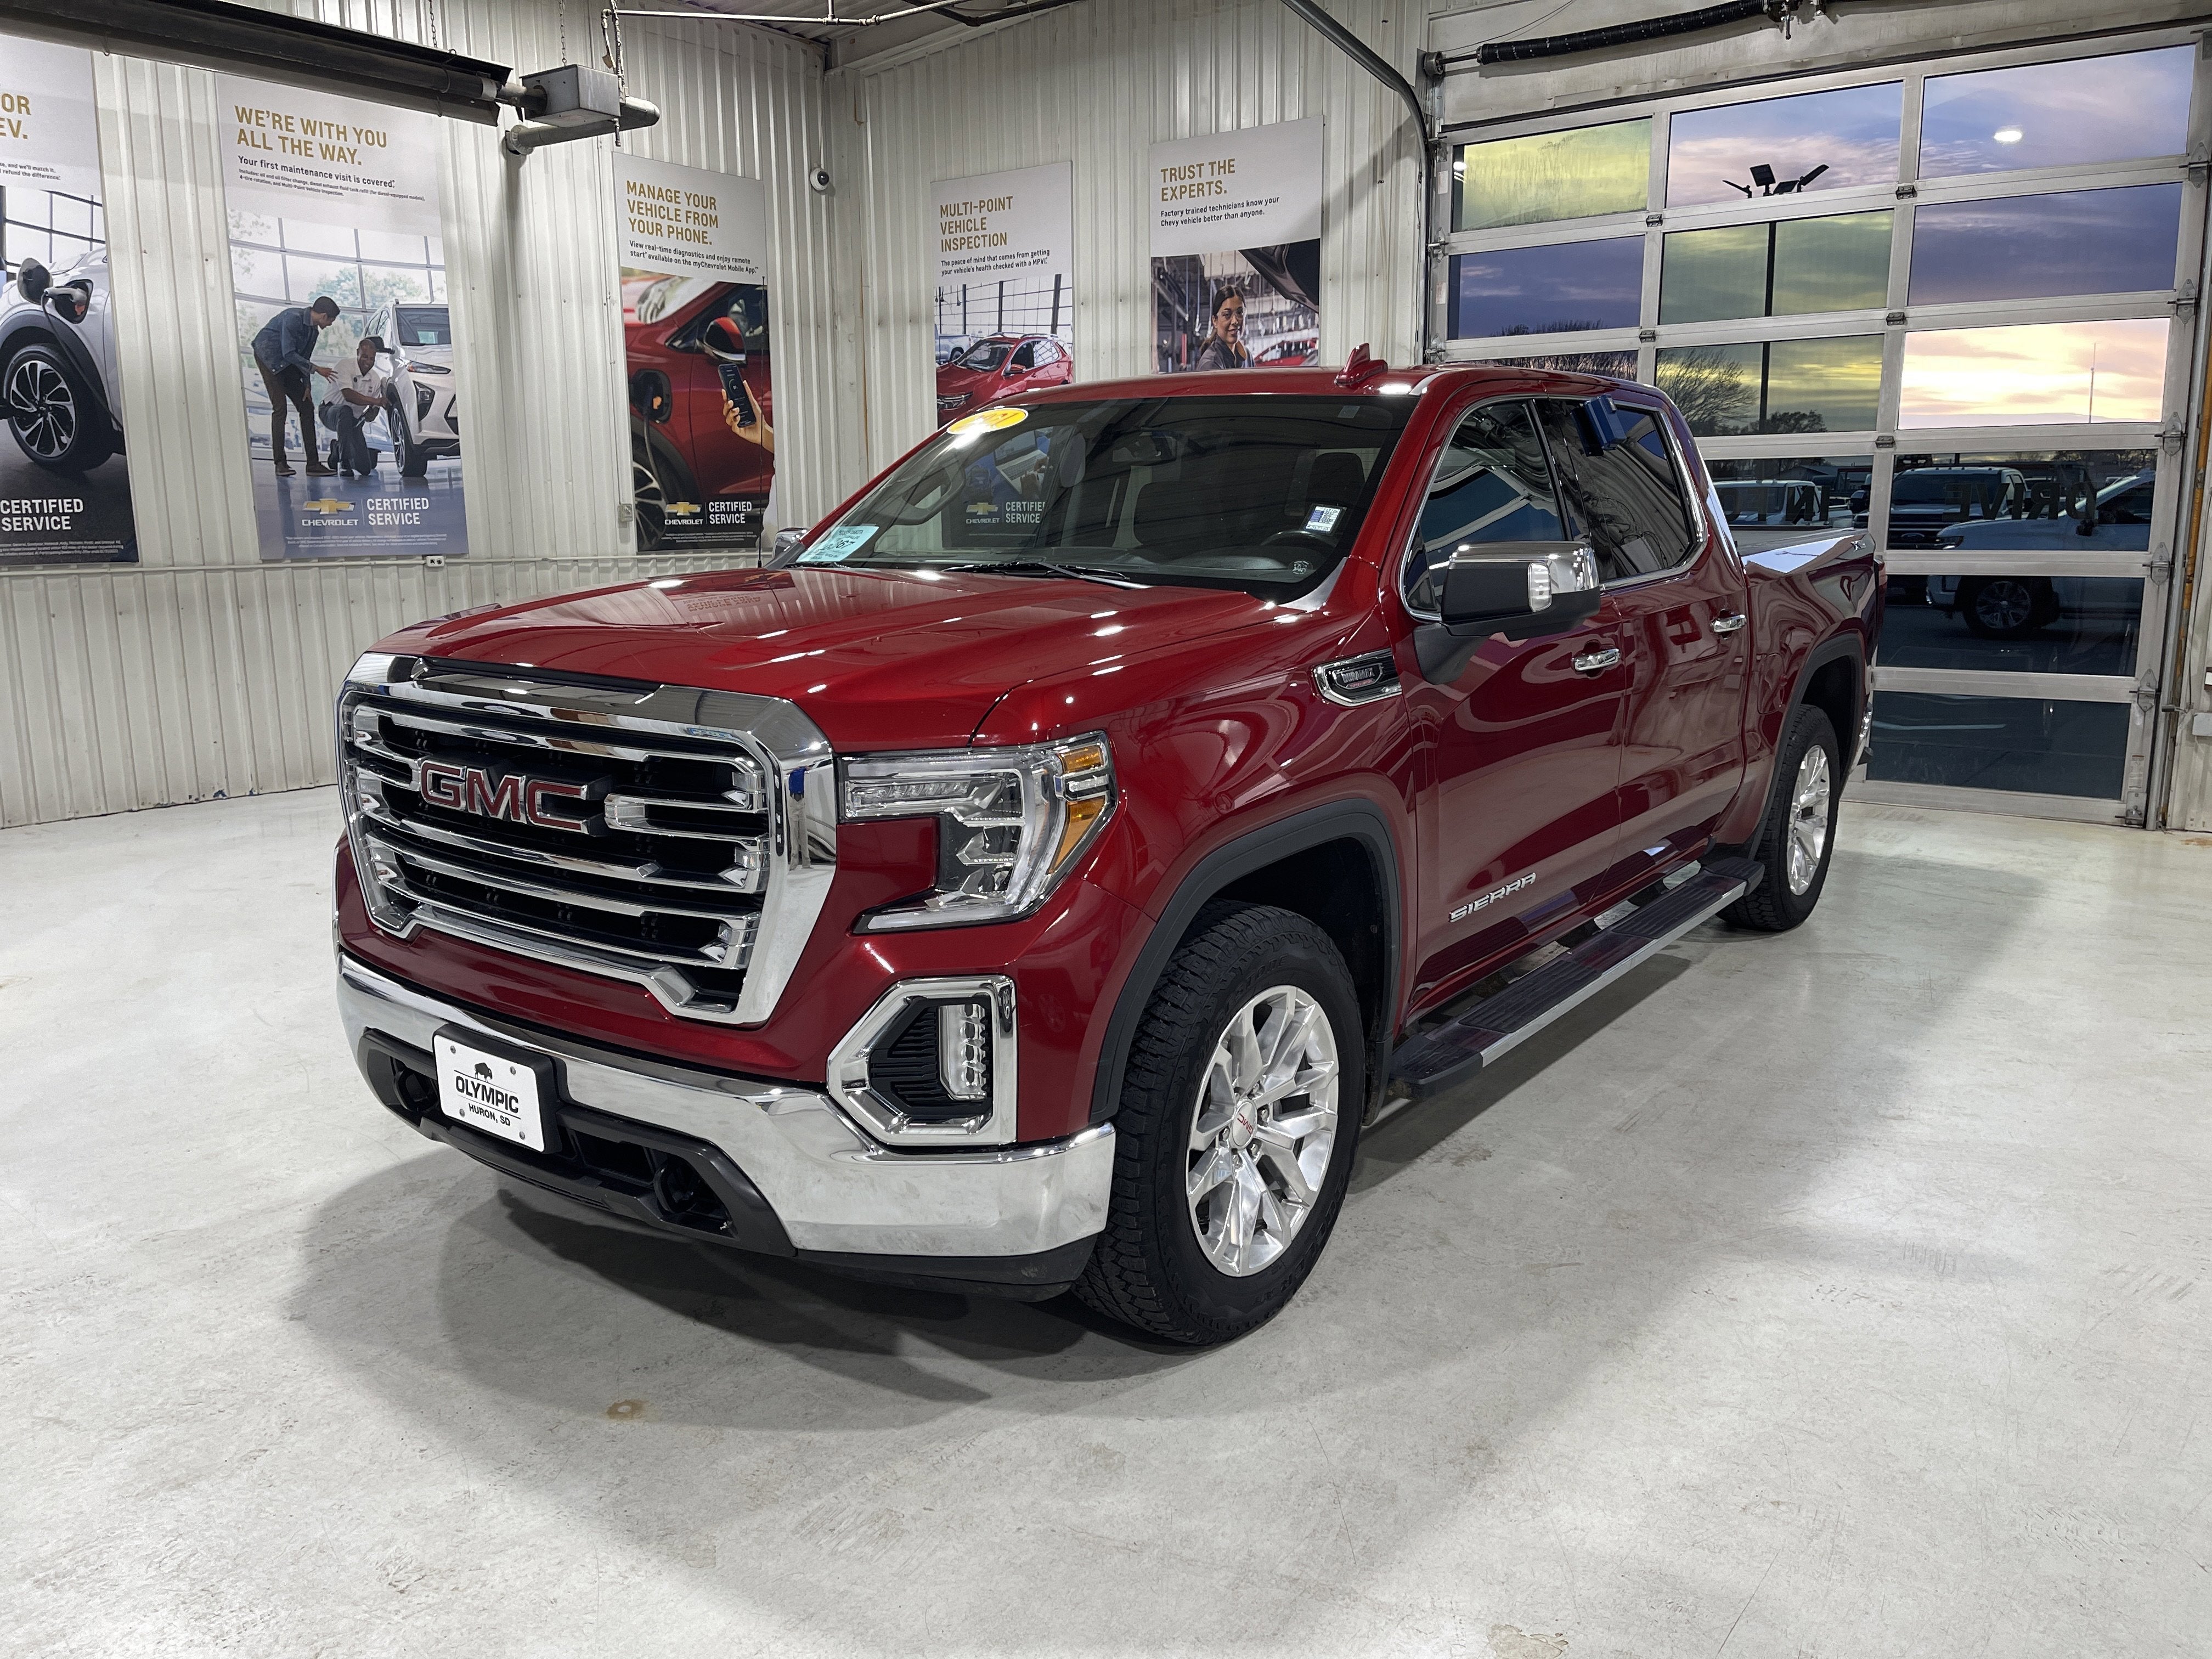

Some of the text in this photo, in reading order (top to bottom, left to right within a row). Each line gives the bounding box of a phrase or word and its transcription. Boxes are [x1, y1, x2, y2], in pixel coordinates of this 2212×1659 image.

[234, 105, 387, 148] WE'RE WITH YOU
[237, 128, 362, 166] ALL THE WAY.
[238, 155, 258, 166] Your
[260, 160, 278, 171] first
[281, 165, 333, 179] maintenance
[335, 172, 352, 183] visit
[353, 174, 360, 184] is
[1161, 159, 1235, 183] TRUST THE
[627, 180, 717, 211] MANAGE YOUR
[1161, 180, 1227, 201] EXPERTS.
[627, 199, 718, 228] VEHICLE FROM
[940, 196, 1013, 218] MULTI-POINT
[1161, 196, 1280, 218] Factory trained technicians know your
[1181, 217, 1201, 225] vehicle
[1240, 209, 1265, 218] anyone.
[628, 217, 712, 245] YOUR PHONE.
[940, 217, 987, 235] VEHICLE
[629, 240, 644, 249] View
[645, 244, 672, 253] real-time
[673, 248, 704, 259] diagnostics
[941, 232, 1007, 252] INSPECTION
[648, 254, 673, 263] available
[693, 261, 726, 270] myChevrolet
[1031, 249, 1049, 259] getting
[953, 266, 974, 274] vehicle's
[993, 262, 1014, 270] checked
[0, 498, 83, 514] CERTIFIED
[366, 497, 429, 511] CERTIFIED
[709, 501, 752, 512] CERTIFIED
[1006, 501, 1046, 511] CERTIFIE
[2, 516, 71, 532] SERVICE
[368, 512, 421, 526] SERVICE
[709, 514, 746, 524] SERVICE
[1006, 514, 1040, 523] SERVICE
[1342, 668, 1375, 683] DURAMAX
[421, 759, 590, 834] GMC
[1448, 872, 1536, 923] SIERRA
[455, 1075, 519, 1114] OLYMPIC
[469, 1103, 511, 1126] HURON, SD
[1237, 1113, 1254, 1135] GMC
